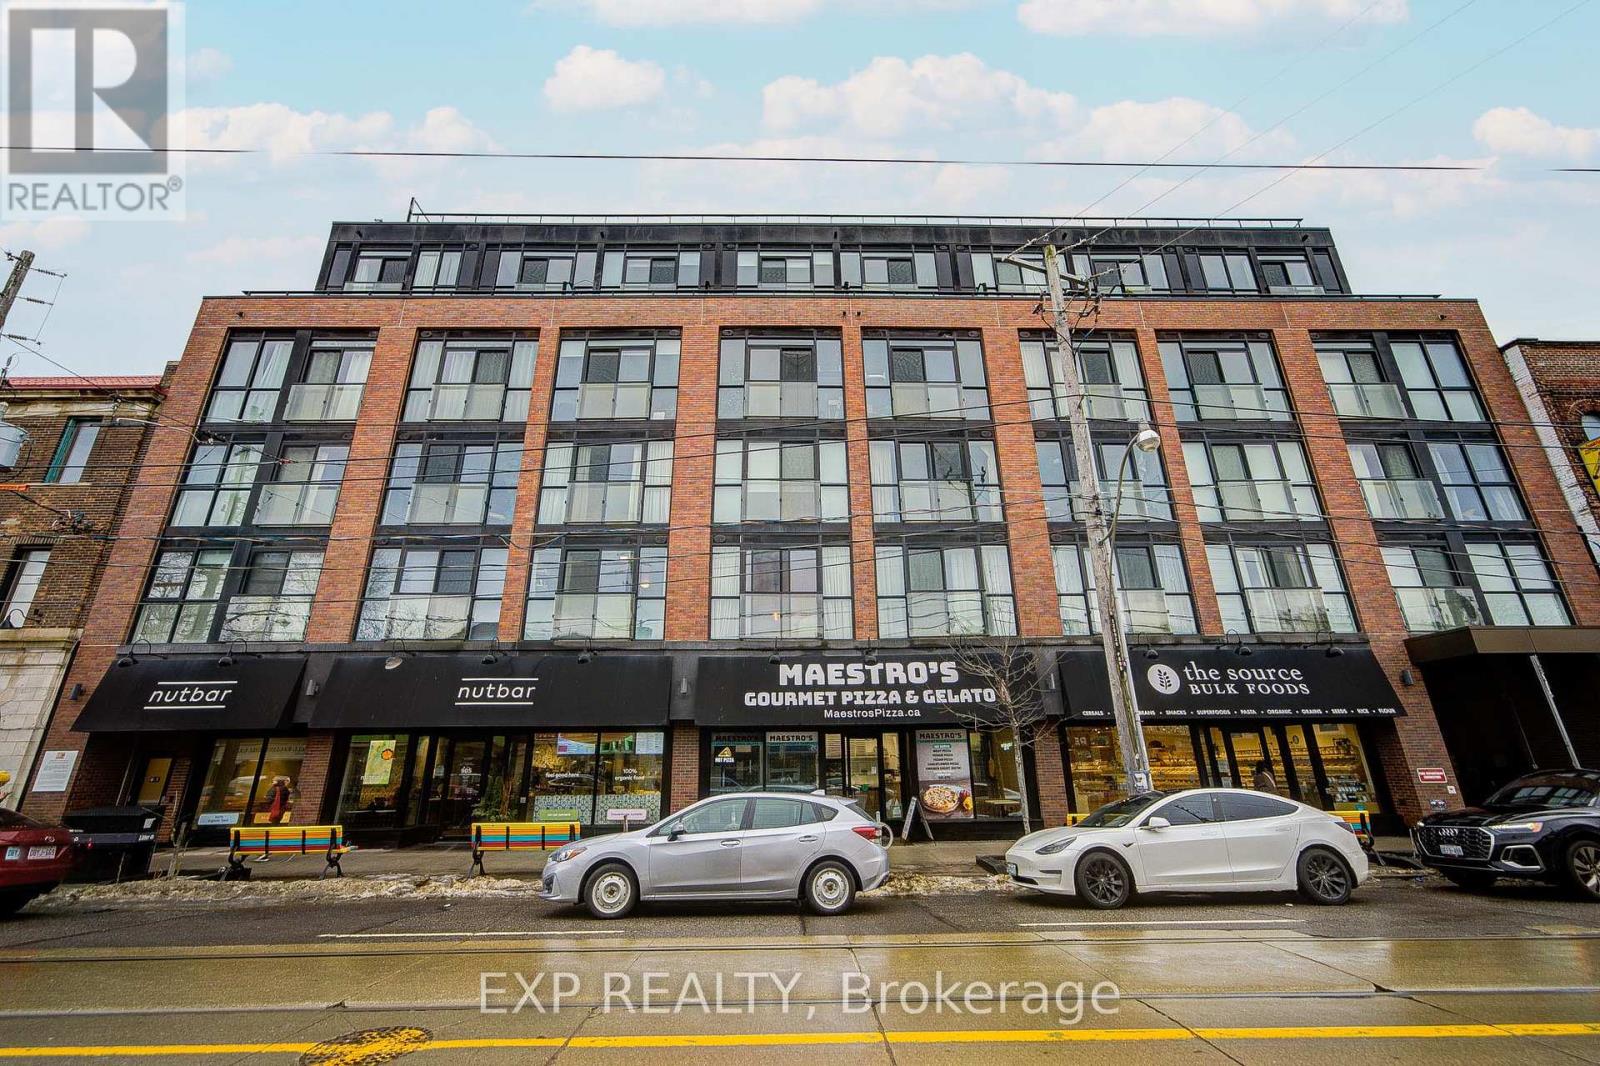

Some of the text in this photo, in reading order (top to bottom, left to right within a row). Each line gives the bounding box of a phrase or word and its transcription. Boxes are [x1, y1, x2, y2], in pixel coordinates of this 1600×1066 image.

[779, 661, 959, 686] MAESTRO'S
[1183, 661, 1304, 681] the source
[148, 687, 232, 703] nutbar
[457, 683, 536, 699] nutbar
[744, 688, 997, 706] GOURMET PIZZA & GELATO
[1188, 683, 1310, 695] BULK FOODS
[824, 708, 921, 719] MaestrosPizza.ca
